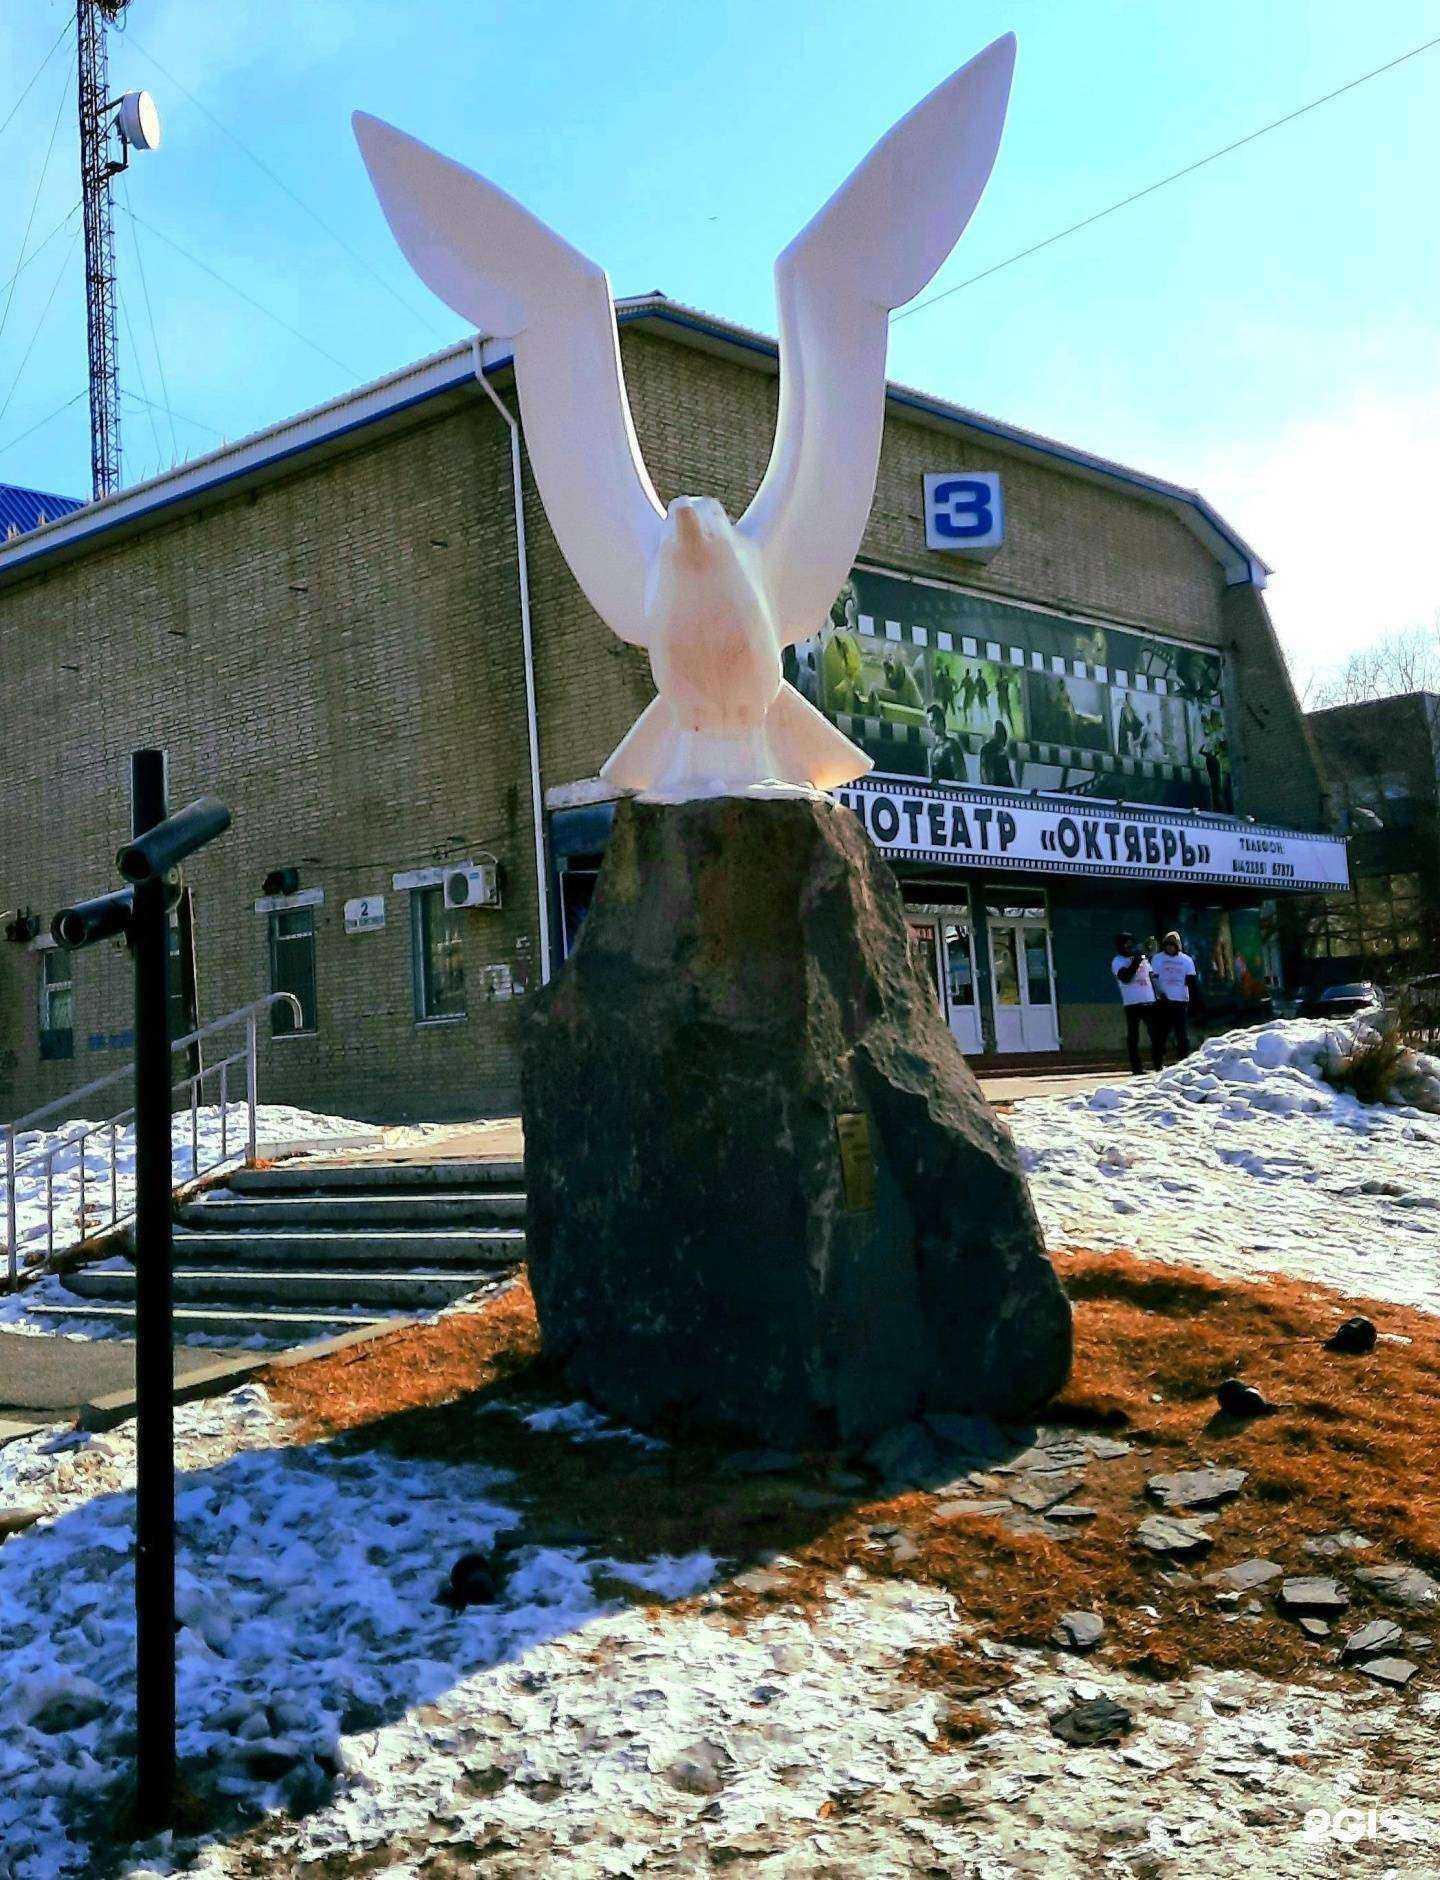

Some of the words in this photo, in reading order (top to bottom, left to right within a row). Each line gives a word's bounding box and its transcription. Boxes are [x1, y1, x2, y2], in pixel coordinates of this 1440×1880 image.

[934, 480, 993, 538] 3
[1041, 817, 1211, 867] «ОКТЯБРЬ»
[360, 902, 369, 917] 2
